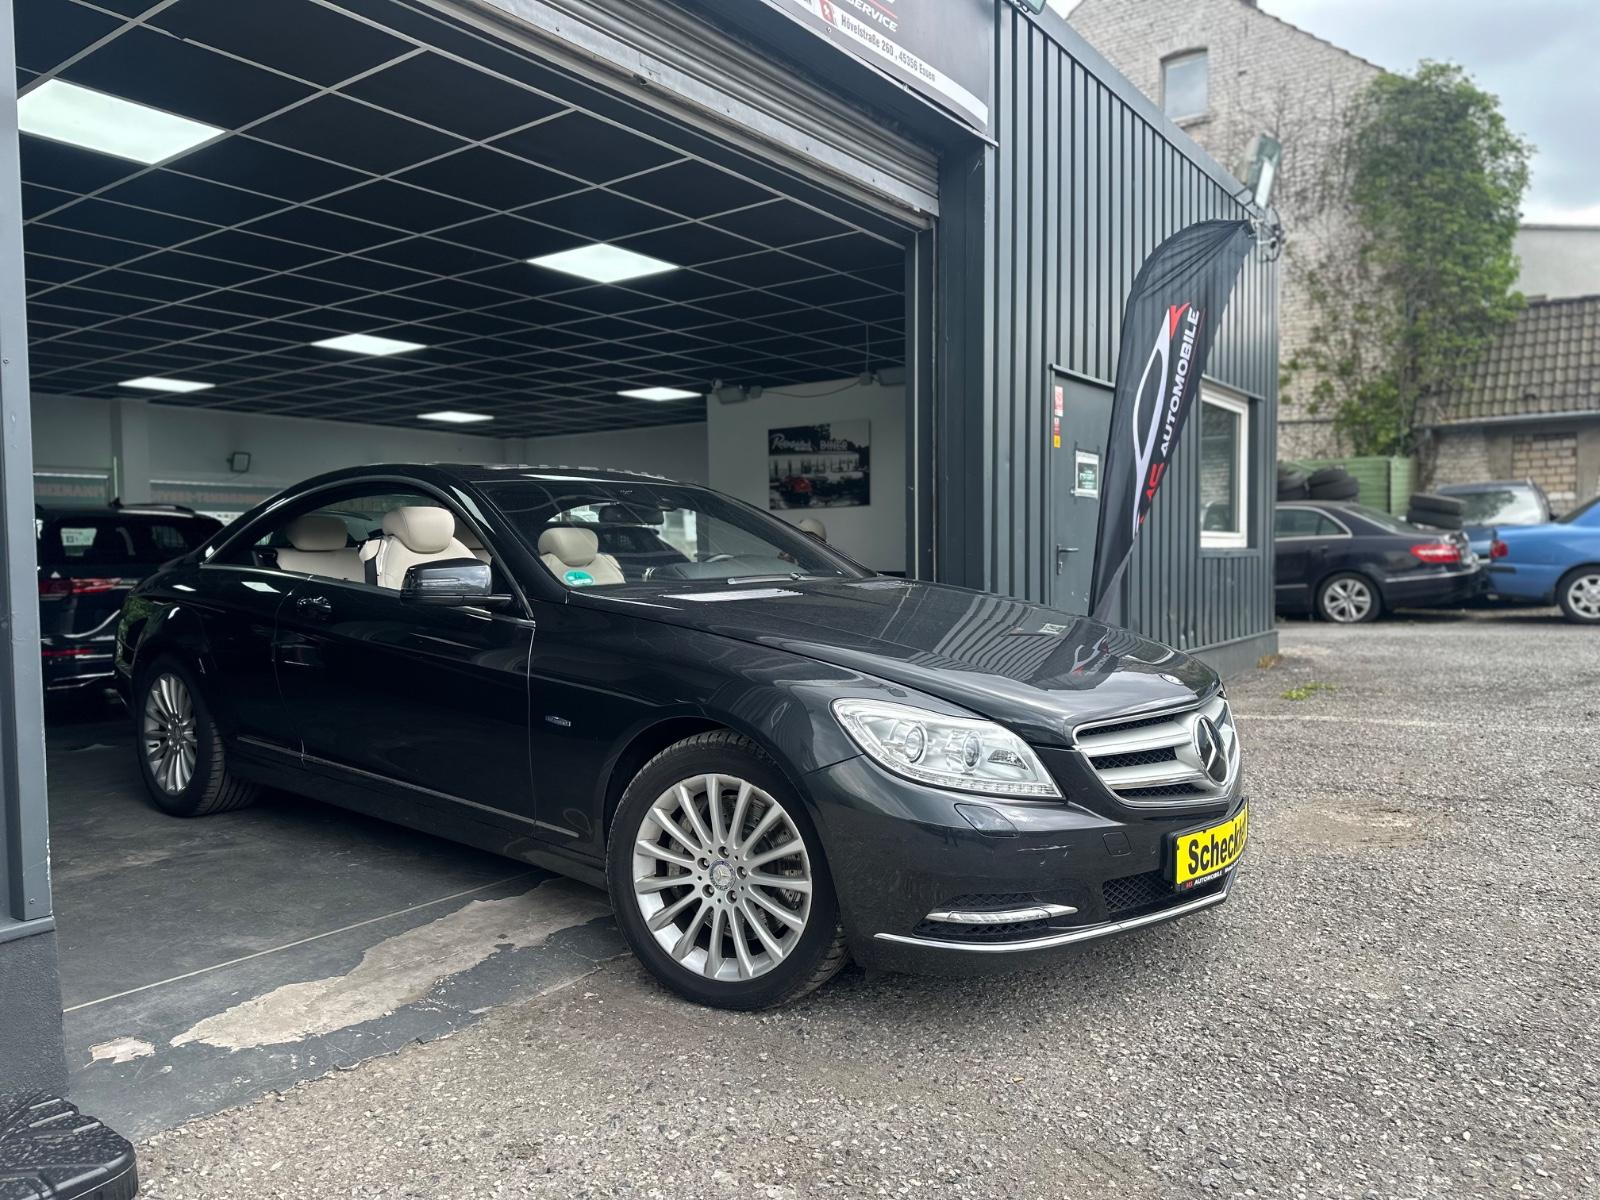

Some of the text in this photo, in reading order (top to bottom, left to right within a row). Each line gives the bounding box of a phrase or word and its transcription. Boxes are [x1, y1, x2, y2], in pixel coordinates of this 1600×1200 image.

[841, 14, 880, 48] Hövelstraße
[881, 40, 894, 56] 260
[1161, 307, 1199, 458] AUTOMOBILE
